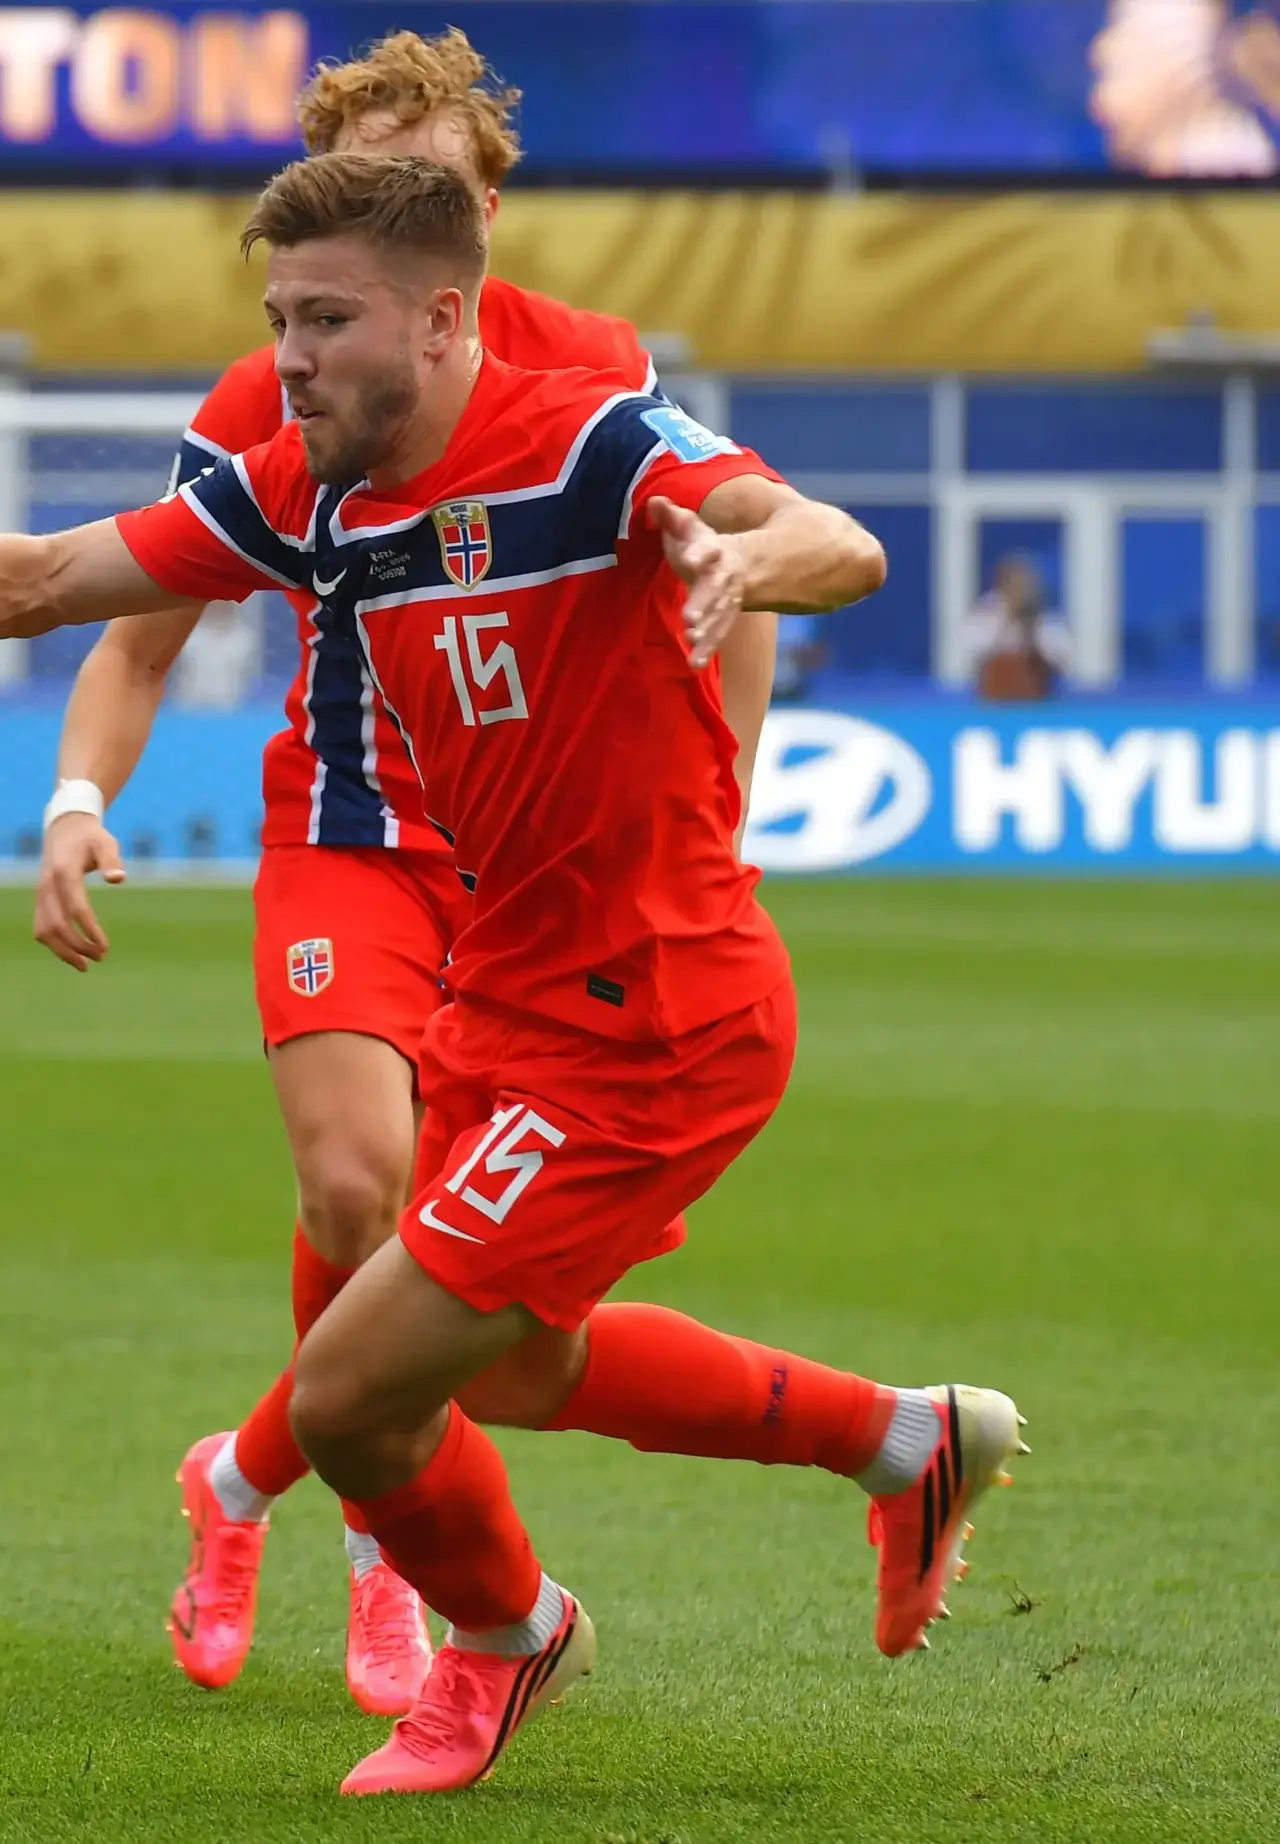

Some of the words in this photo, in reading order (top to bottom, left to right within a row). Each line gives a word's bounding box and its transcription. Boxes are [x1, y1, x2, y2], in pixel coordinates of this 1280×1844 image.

[432, 611, 529, 726] 15
[952, 727, 1280, 853] HYU
[444, 1103, 567, 1225] 15
